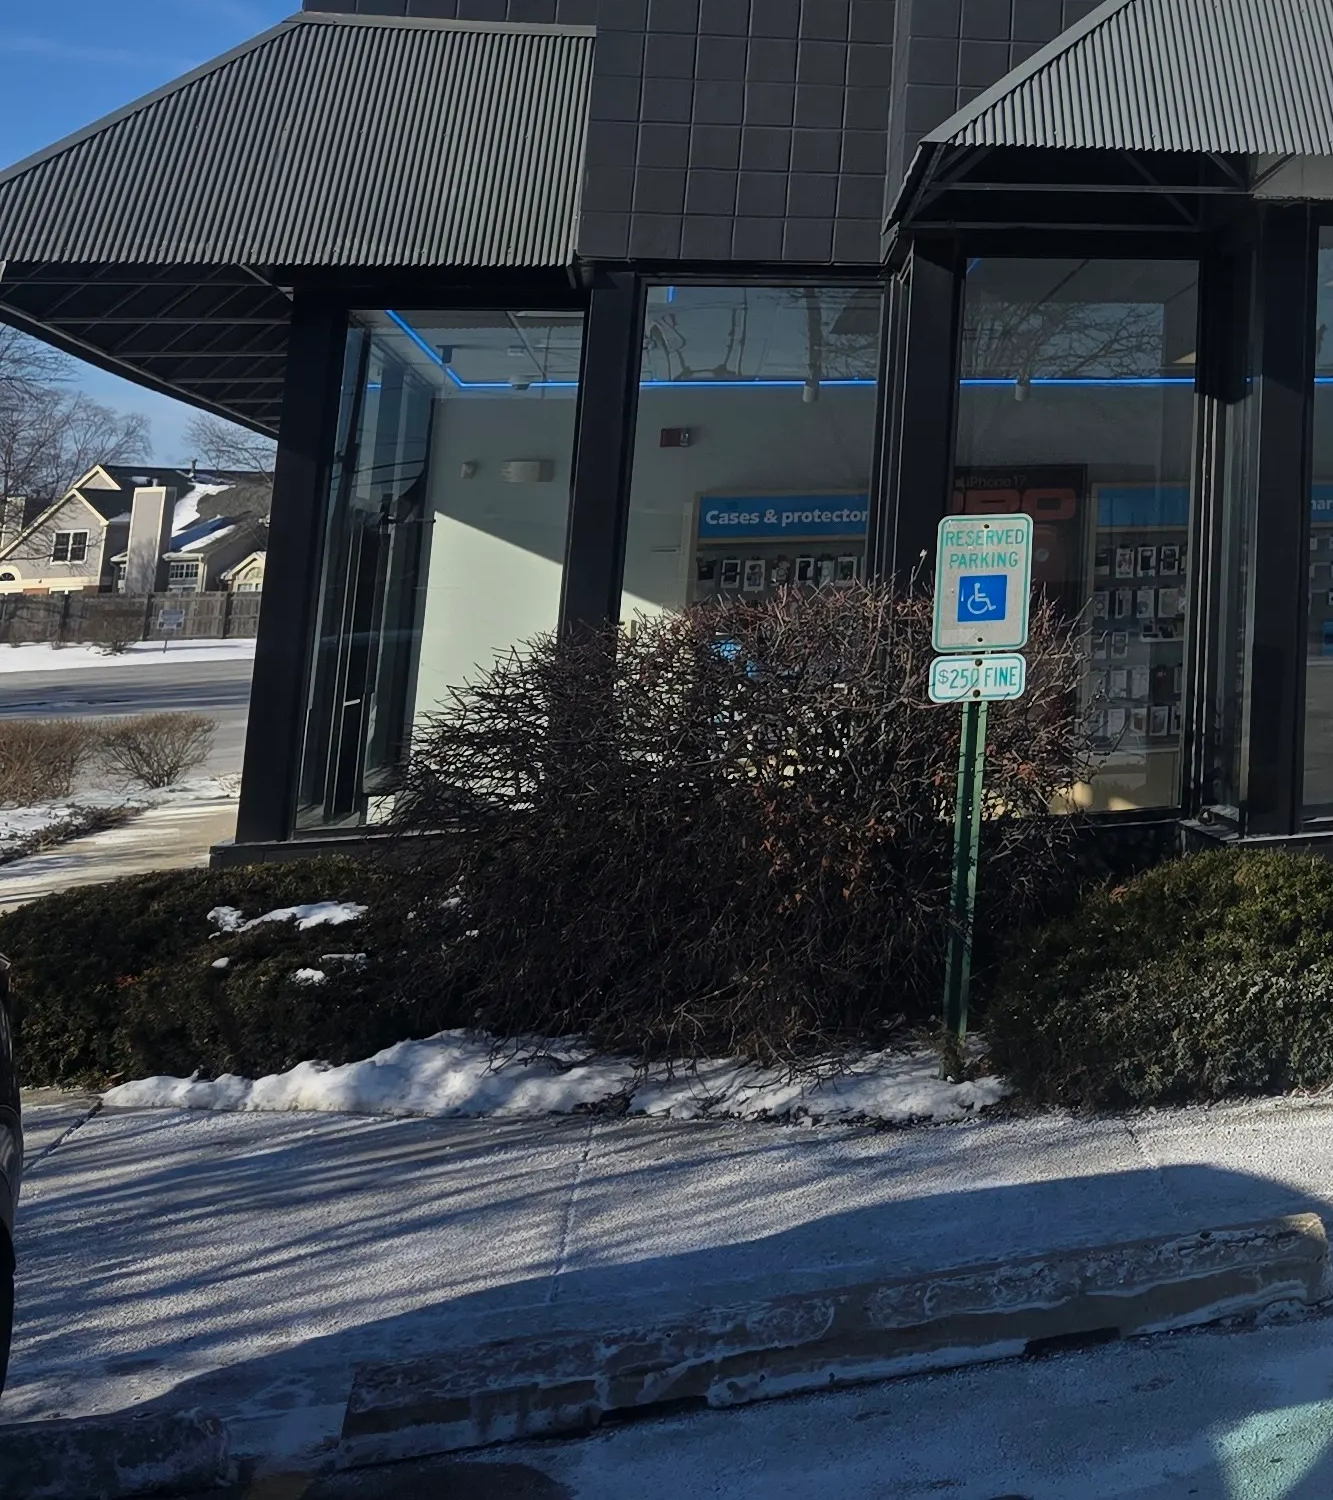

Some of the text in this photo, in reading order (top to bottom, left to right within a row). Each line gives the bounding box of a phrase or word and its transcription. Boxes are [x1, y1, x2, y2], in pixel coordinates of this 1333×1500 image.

[705, 510, 760, 525] Cases
[763, 508, 778, 524] &
[945, 529, 1024, 547] RESERVED
[949, 552, 1019, 569] PARKING
[938, 666, 1018, 689] $250 FINE
